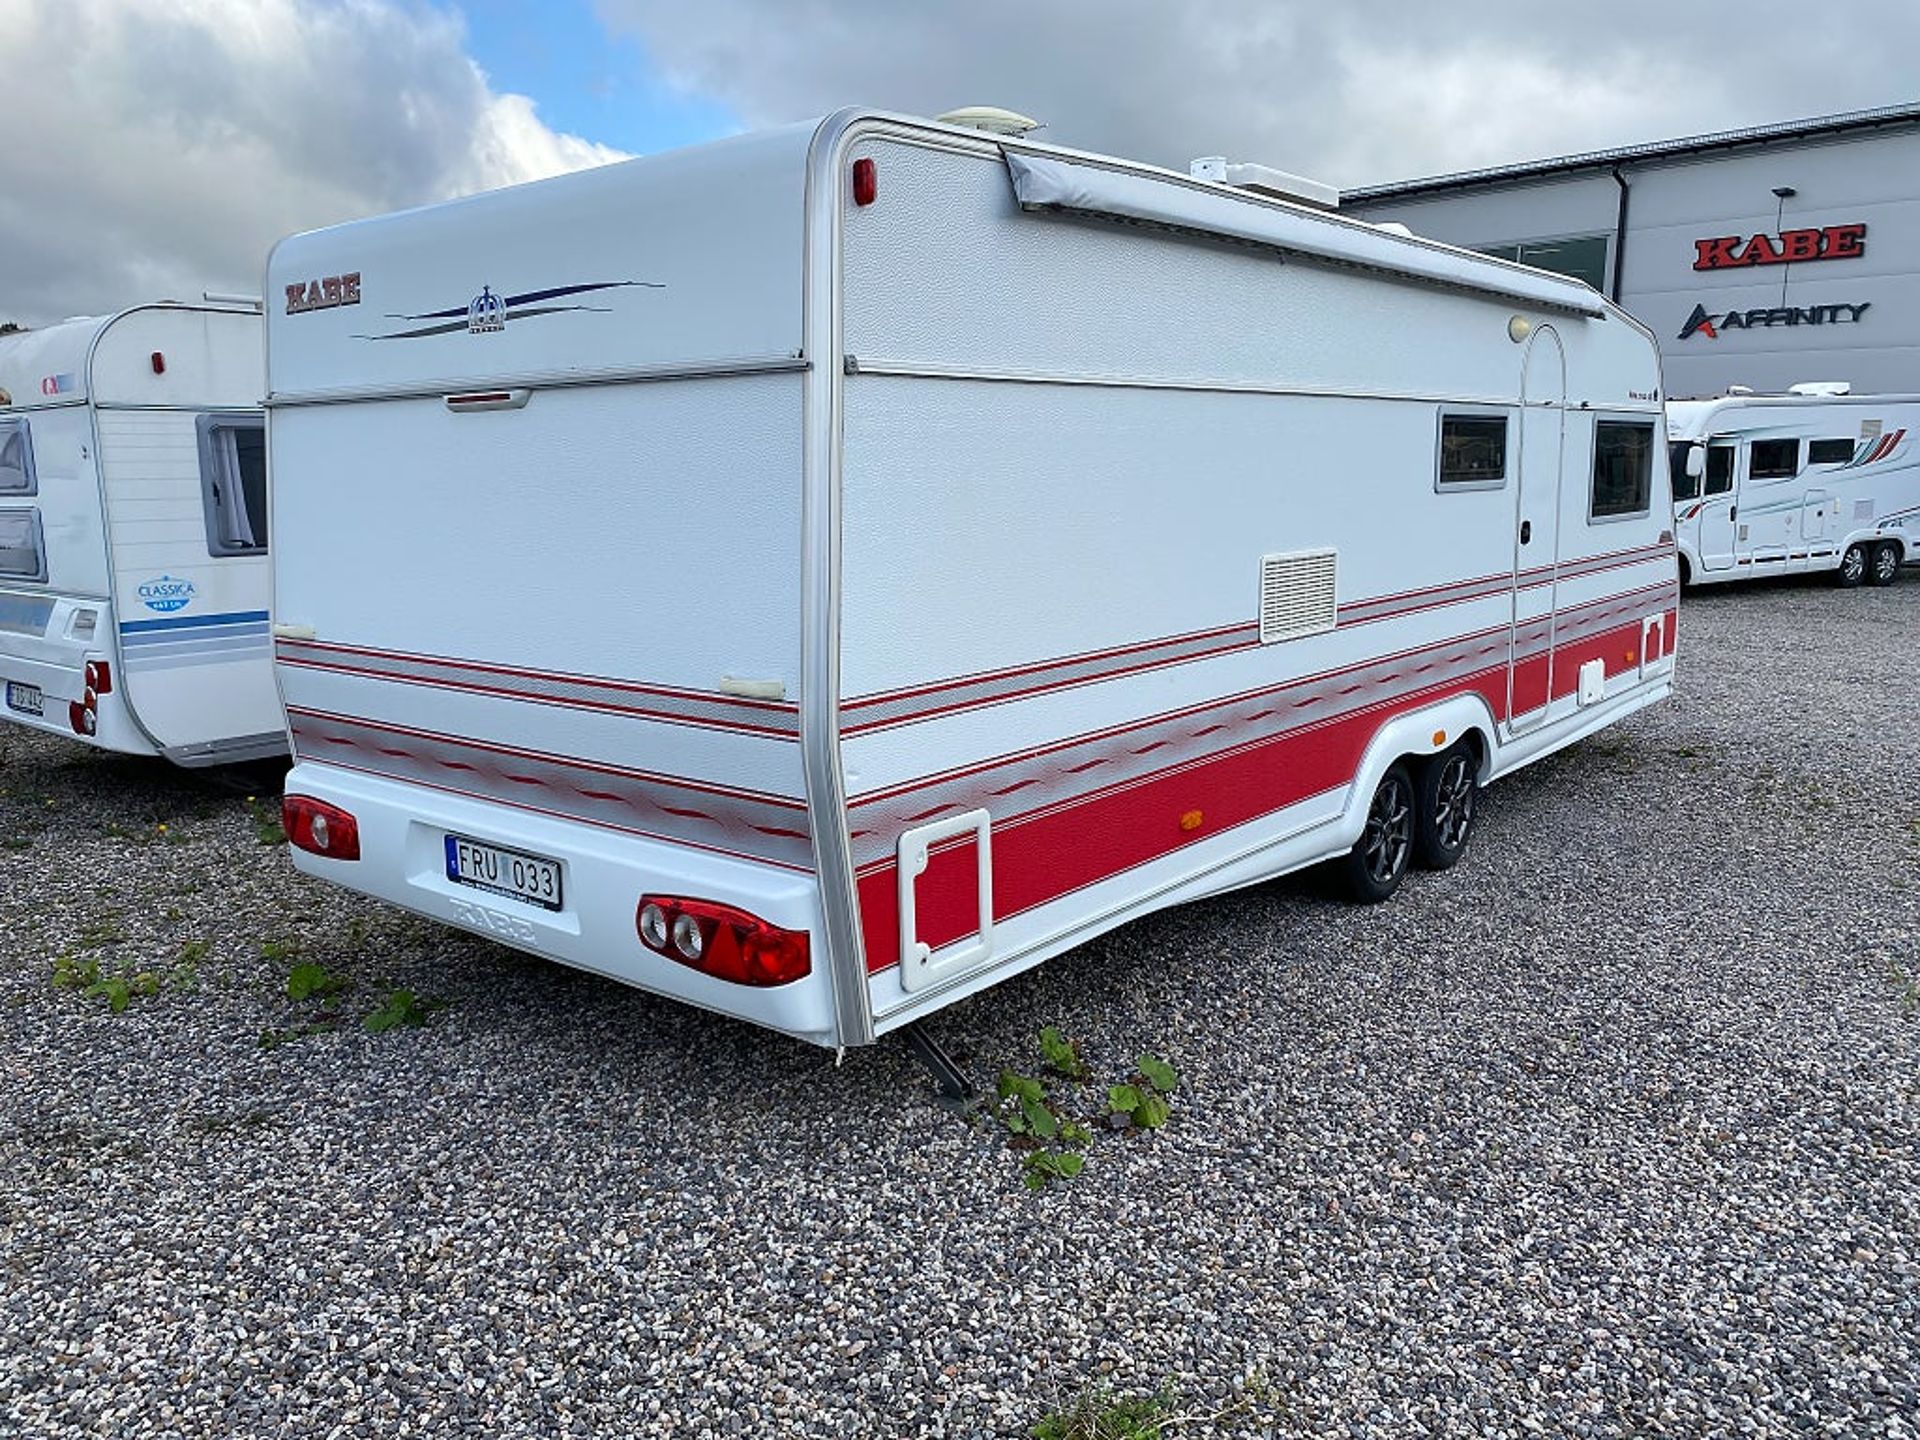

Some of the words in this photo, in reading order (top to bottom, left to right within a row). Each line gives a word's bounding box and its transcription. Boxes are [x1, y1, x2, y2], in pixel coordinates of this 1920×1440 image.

[1693, 223, 1867, 271] KABE
[286, 272, 361, 314] KABE
[1720, 303, 1871, 330] AFFINITY
[458, 845, 498, 881] FRU
[513, 860, 554, 897] 033
